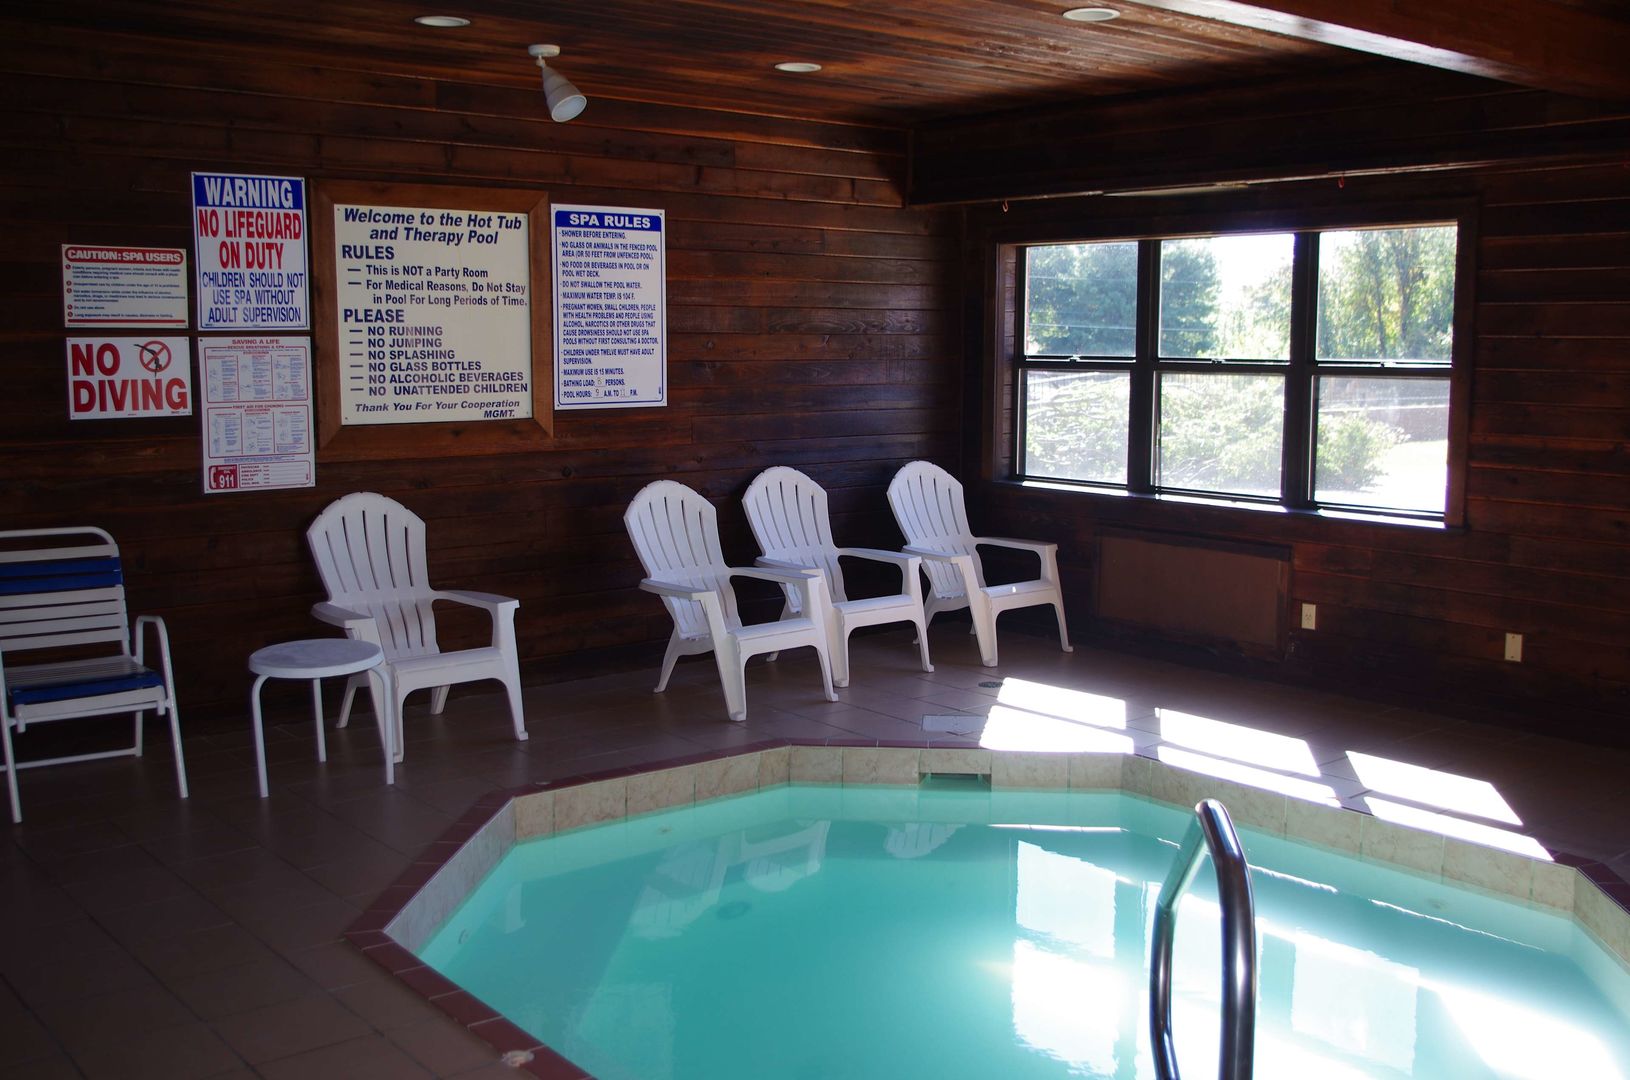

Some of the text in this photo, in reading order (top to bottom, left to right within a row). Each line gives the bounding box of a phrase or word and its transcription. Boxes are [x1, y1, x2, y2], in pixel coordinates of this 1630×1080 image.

[204, 177, 293, 209] WARNING
[198, 209, 302, 240] NO LIFEGUARD
[344, 208, 522, 230] Welcome to the Hot Tub
[570, 214, 651, 228] SPA RULES
[370, 226, 499, 246] and Therapy Pool
[561, 230, 582, 238] SHOWER
[68, 250, 181, 262] CAUTION: SPA USERS
[219, 241, 285, 270] ON DUTY
[342, 245, 395, 260] RULES
[366, 265, 388, 275] This
[391, 266, 399, 275] is
[403, 266, 423, 276] NOT
[435, 267, 460, 279] Party
[463, 268, 488, 278] Room
[202, 272, 304, 288] CHILDREN SHOULD NOT
[366, 280, 526, 295] For Medical Reasons, Do Not Stay
[213, 290, 295, 305] USE SPA WITHOUT
[373, 294, 527, 307] in Pool For Long Periods of Time.
[208, 307, 301, 322] ADULT SUPERVISION
[344, 309, 405, 323] PLEASE
[368, 327, 443, 336] NO RUNNING
[368, 339, 442, 348] NO JUMPING
[71, 343, 120, 376] NO
[368, 350, 455, 360] NO SPLASHING
[368, 361, 481, 372] NO GLASS BOTTLES
[369, 372, 523, 384] NO ALCOHOLIC BEVERAGES
[73, 378, 188, 412] DIVING
[369, 383, 528, 396] NO UNATTENDED CHILDREN
[355, 399, 520, 412] Thank You For Your Cooperation
[484, 409, 515, 418] MGMT.
[220, 475, 234, 488] 911
